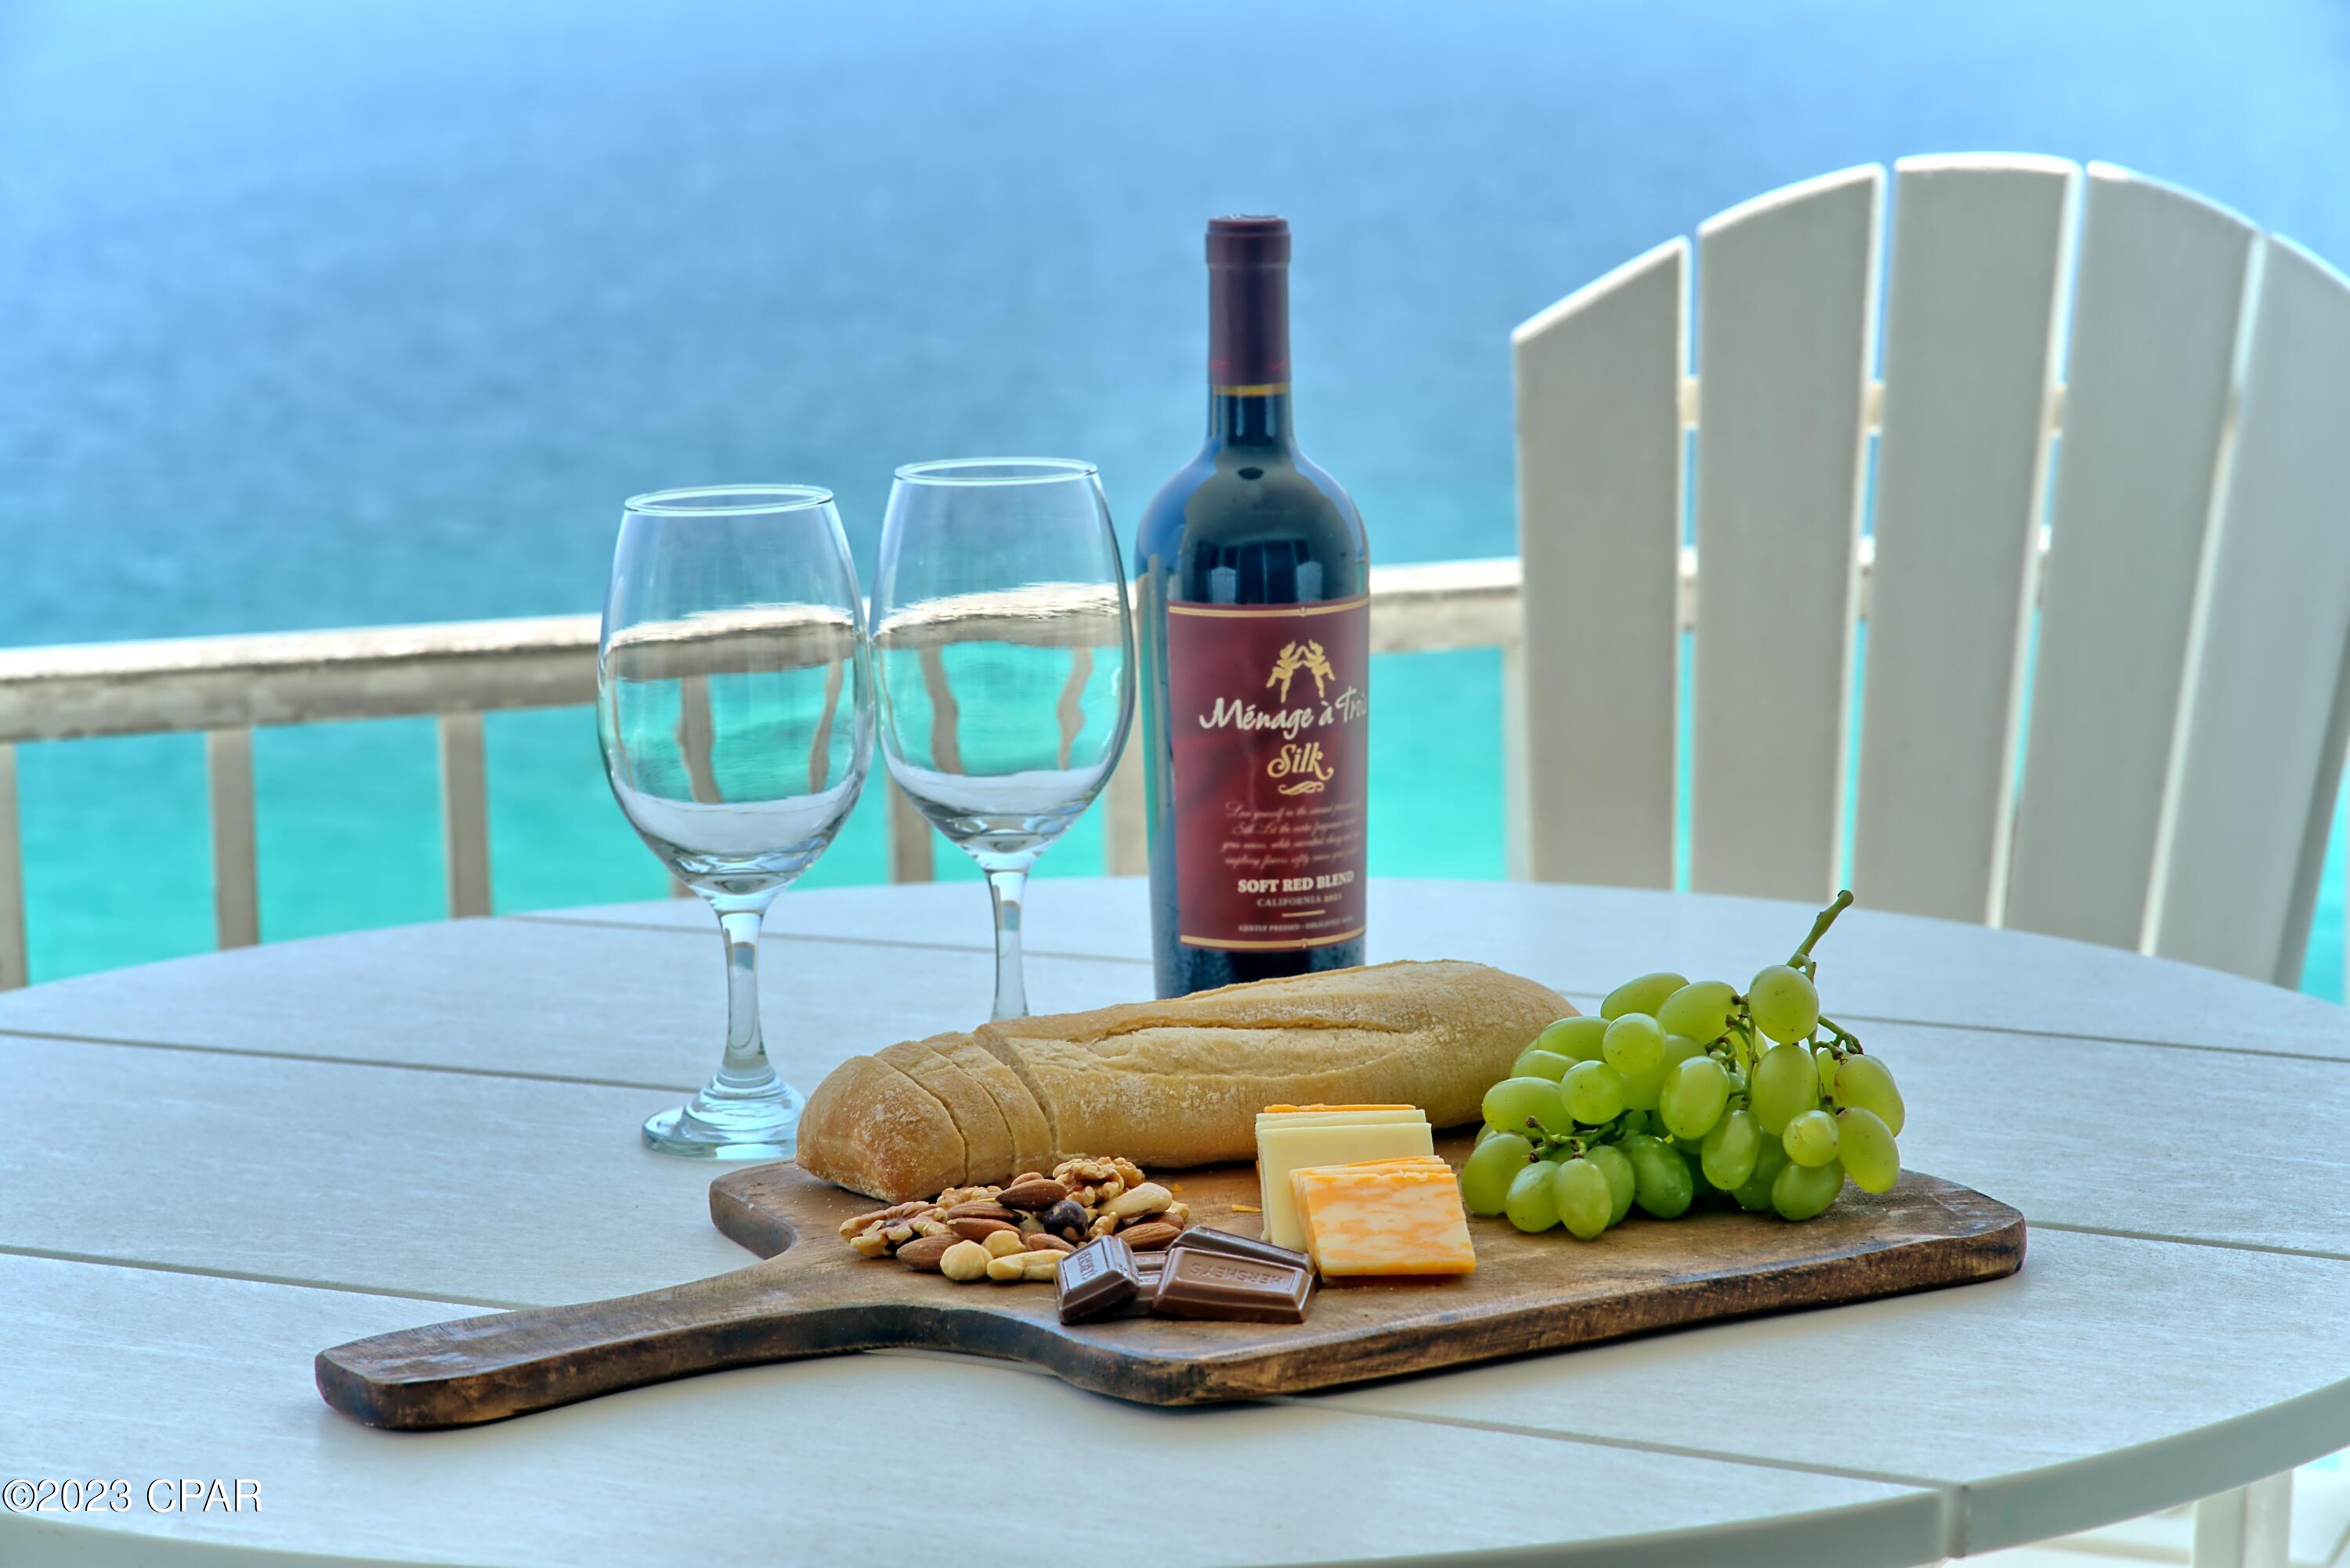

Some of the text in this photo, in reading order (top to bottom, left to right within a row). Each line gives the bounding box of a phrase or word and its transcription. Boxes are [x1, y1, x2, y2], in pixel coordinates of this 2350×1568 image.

[1198, 696, 1314, 740] Ménage
[1318, 700, 1335, 727] à
[1267, 742, 1335, 781] Silk
[1237, 870, 1354, 893] SOFT RED BLEND
[1256, 896, 1321, 907] CALIFORNIA
